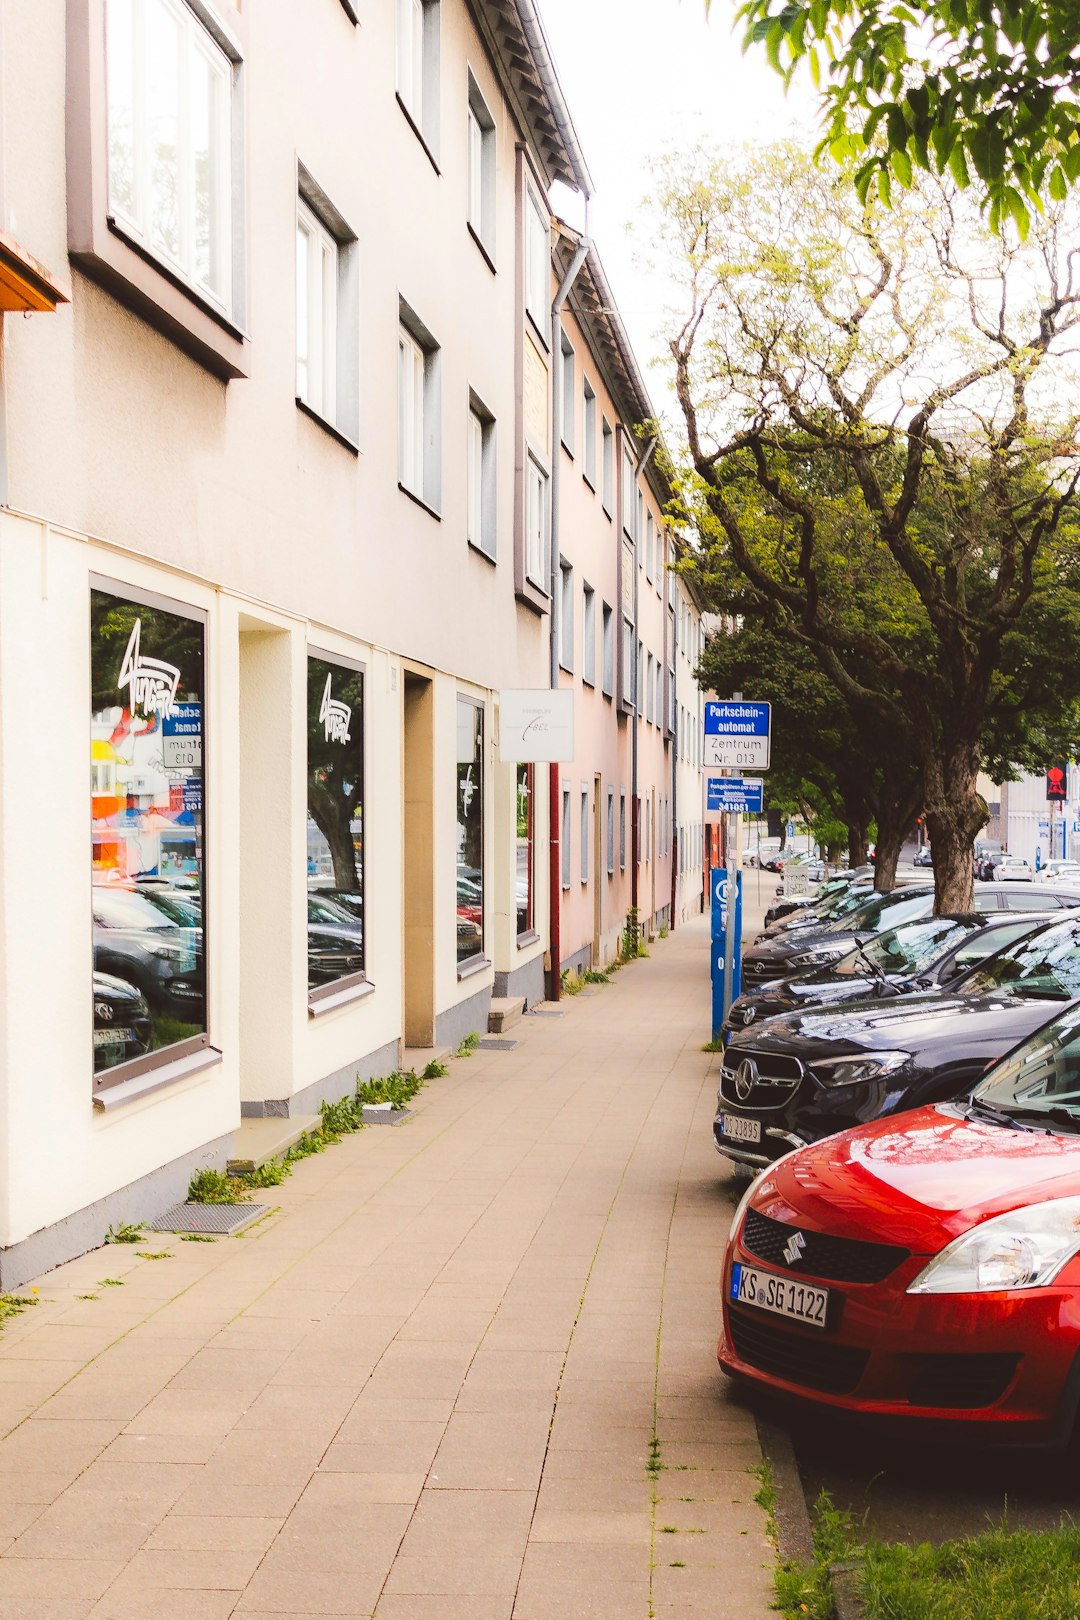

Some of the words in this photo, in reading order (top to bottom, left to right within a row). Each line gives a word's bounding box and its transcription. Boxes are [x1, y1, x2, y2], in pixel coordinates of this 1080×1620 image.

[710, 705, 764, 718] Parkschein-
[718, 721, 756, 733] automat
[711, 737, 762, 750] Zentrum
[714, 753, 731, 764] Nr.
[736, 753, 755, 764] 013
[718, 802, 749, 811] 341051
[739, 1270, 758, 1300] KS
[766, 1279, 785, 1310] SG
[787, 1285, 825, 1322] 1122
